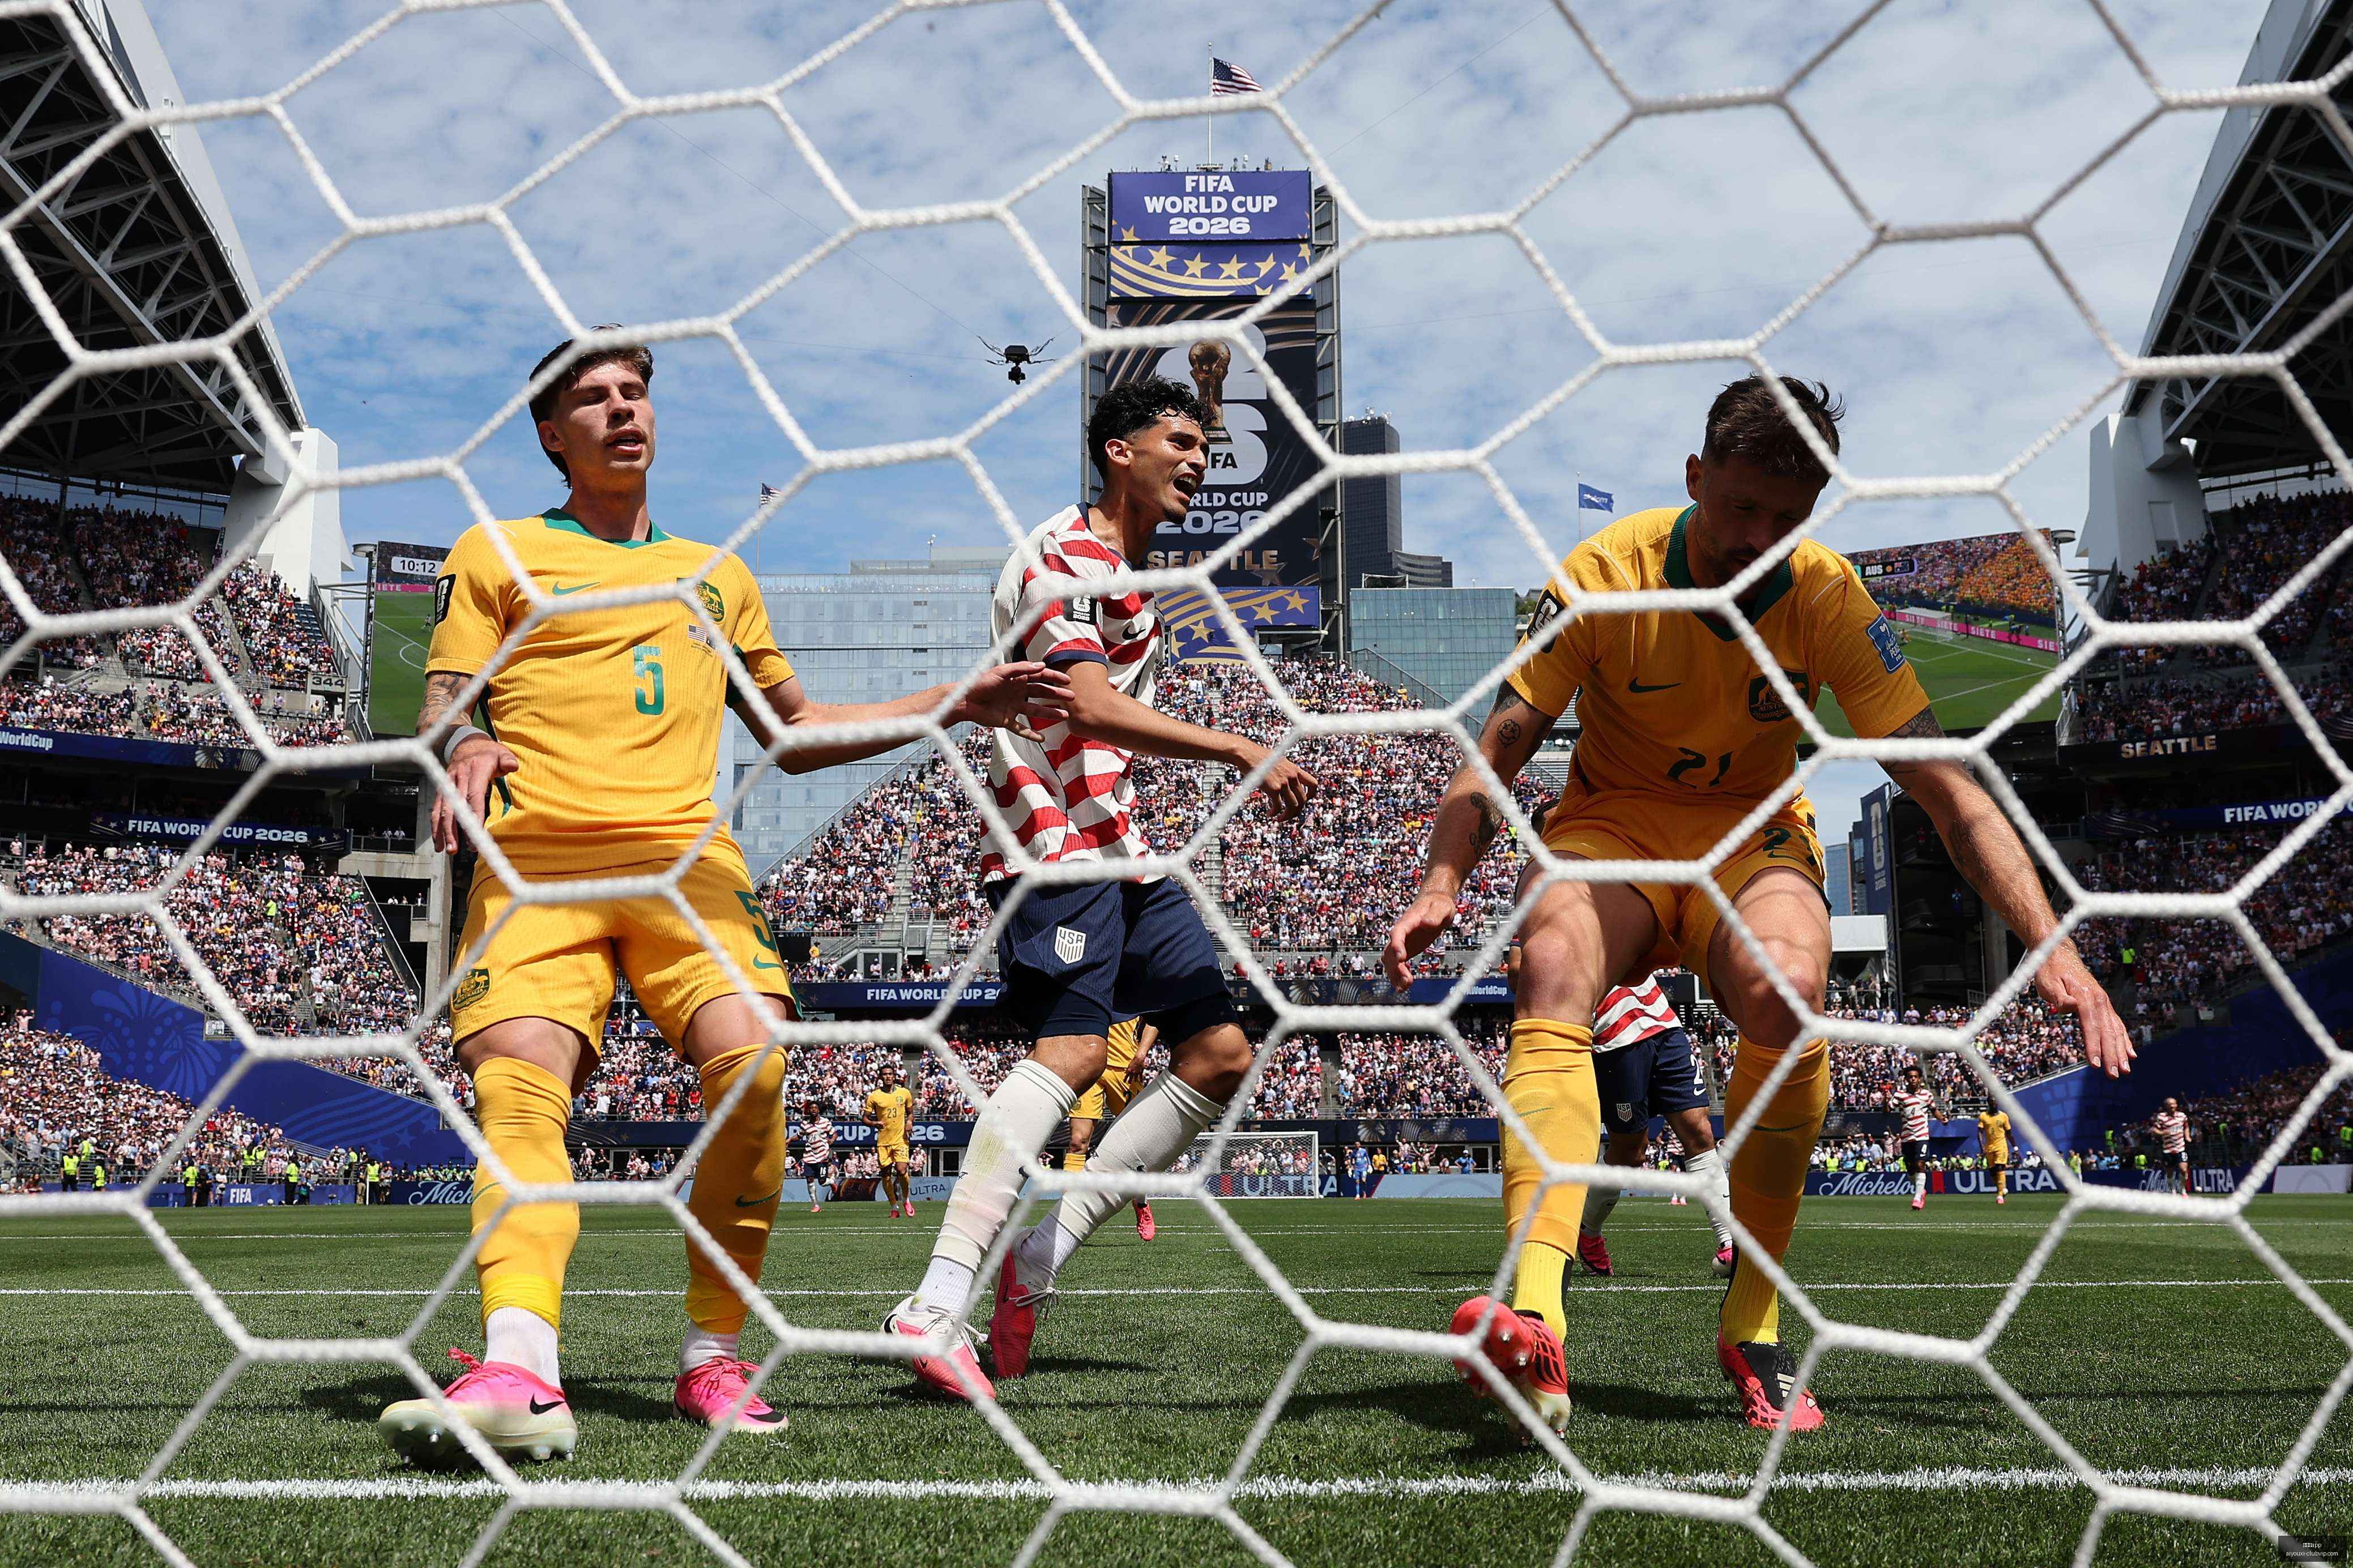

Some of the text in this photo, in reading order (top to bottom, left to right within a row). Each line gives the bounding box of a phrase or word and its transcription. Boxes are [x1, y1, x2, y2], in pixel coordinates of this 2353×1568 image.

[1185, 175, 1235, 193] FIFA
[1144, 195, 1278, 214] WORLD CUP
[1169, 216, 1251, 235] 2026
[1205, 452, 1238, 469] FA
[1190, 492, 1269, 507] RLD CUP
[400, 559, 436, 574] 10:12
[1865, 564, 1883, 576] AUS
[1970, 626, 1996, 639] SIETE
[312, 676, 345, 688] 344
[633, 646, 664, 716] 5
[0, 730, 53, 751] WorldCup
[2121, 735, 2216, 759] SEATTLE
[1666, 746, 1734, 789] 21
[2224, 805, 2268, 823] FIFA
[2269, 800, 2328, 819] WOR
[127, 819, 308, 843] FIFA WORL CUP 2026
[734, 890, 778, 954] 5
[1059, 929, 1084, 945] USA
[867, 989, 898, 1000] FIFA
[1450, 985, 1507, 997] #WorldCup
[887, 1108, 897, 1119] 23
[820, 1167, 826, 1175] 16
[1819, 1172, 1916, 1196] Michelo
[2192, 1169, 2235, 1193] ULTRA
[230, 1188, 253, 1203] FIFA
[910, 1184, 947, 1196] ULTRA
